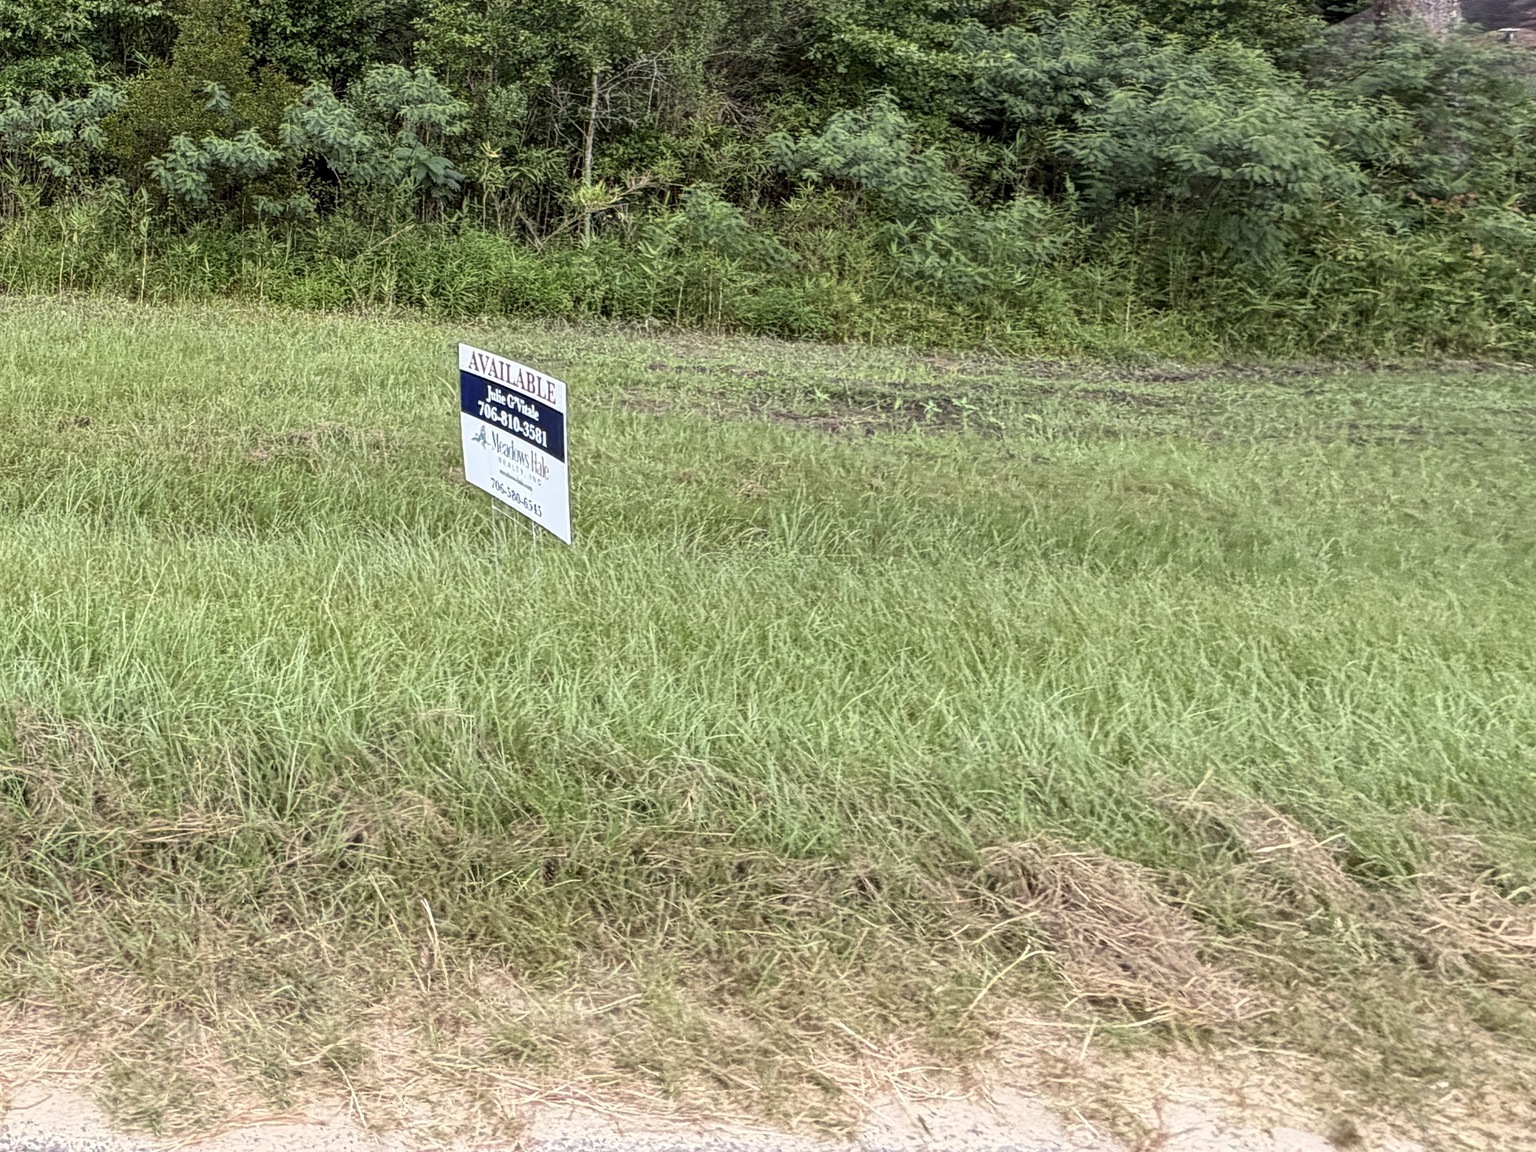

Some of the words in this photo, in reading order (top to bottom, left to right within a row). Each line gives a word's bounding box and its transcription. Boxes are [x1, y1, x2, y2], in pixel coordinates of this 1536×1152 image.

[468, 350, 557, 405] AVAILABLE
[485, 384, 506, 406] Julie
[477, 400, 548, 448] 706-810-3581
[491, 430, 530, 469] Meadows
[530, 450, 550, 481] Hale
